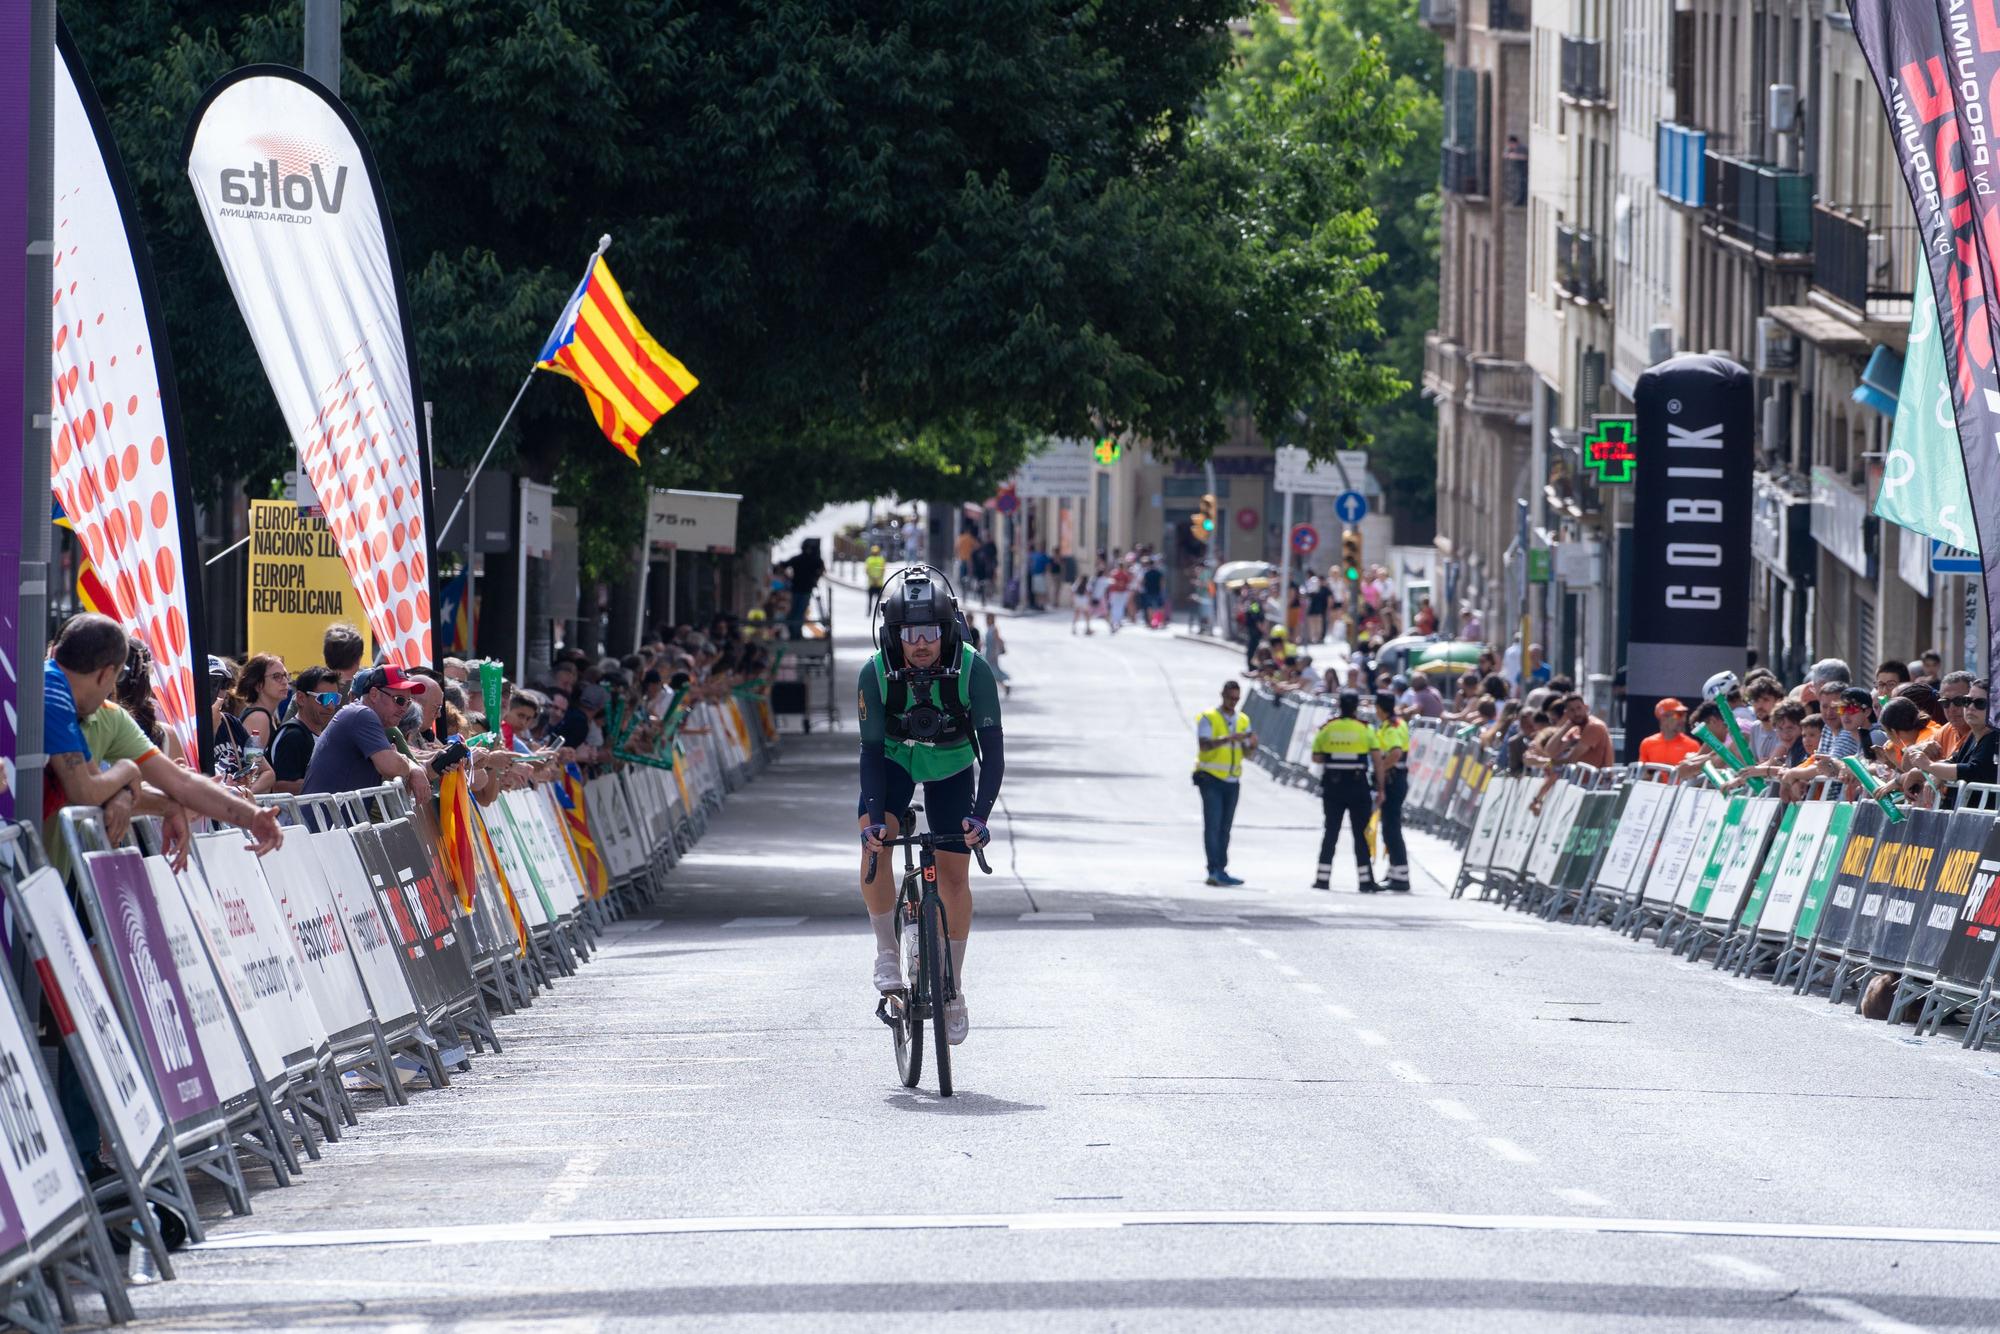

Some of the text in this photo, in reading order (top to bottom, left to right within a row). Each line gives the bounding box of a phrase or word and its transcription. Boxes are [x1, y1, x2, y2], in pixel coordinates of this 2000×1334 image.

[654, 512, 698, 527] 75 m
[1665, 422, 1724, 610] GOBIK
[254, 531, 314, 557] NACIONS
[253, 562, 306, 588] EUROPA
[252, 588, 343, 615] REPUBLICANA
[1840, 834, 1875, 877] MORITZ
[1891, 844, 1935, 892] MORITZ
[1935, 847, 1981, 896] MORITZ
[1885, 898, 1916, 926] BARCELONA
[1926, 903, 1959, 931] BARCELONA
[297, 903, 345, 973] esportcat
[129, 950, 193, 1073] Volta
